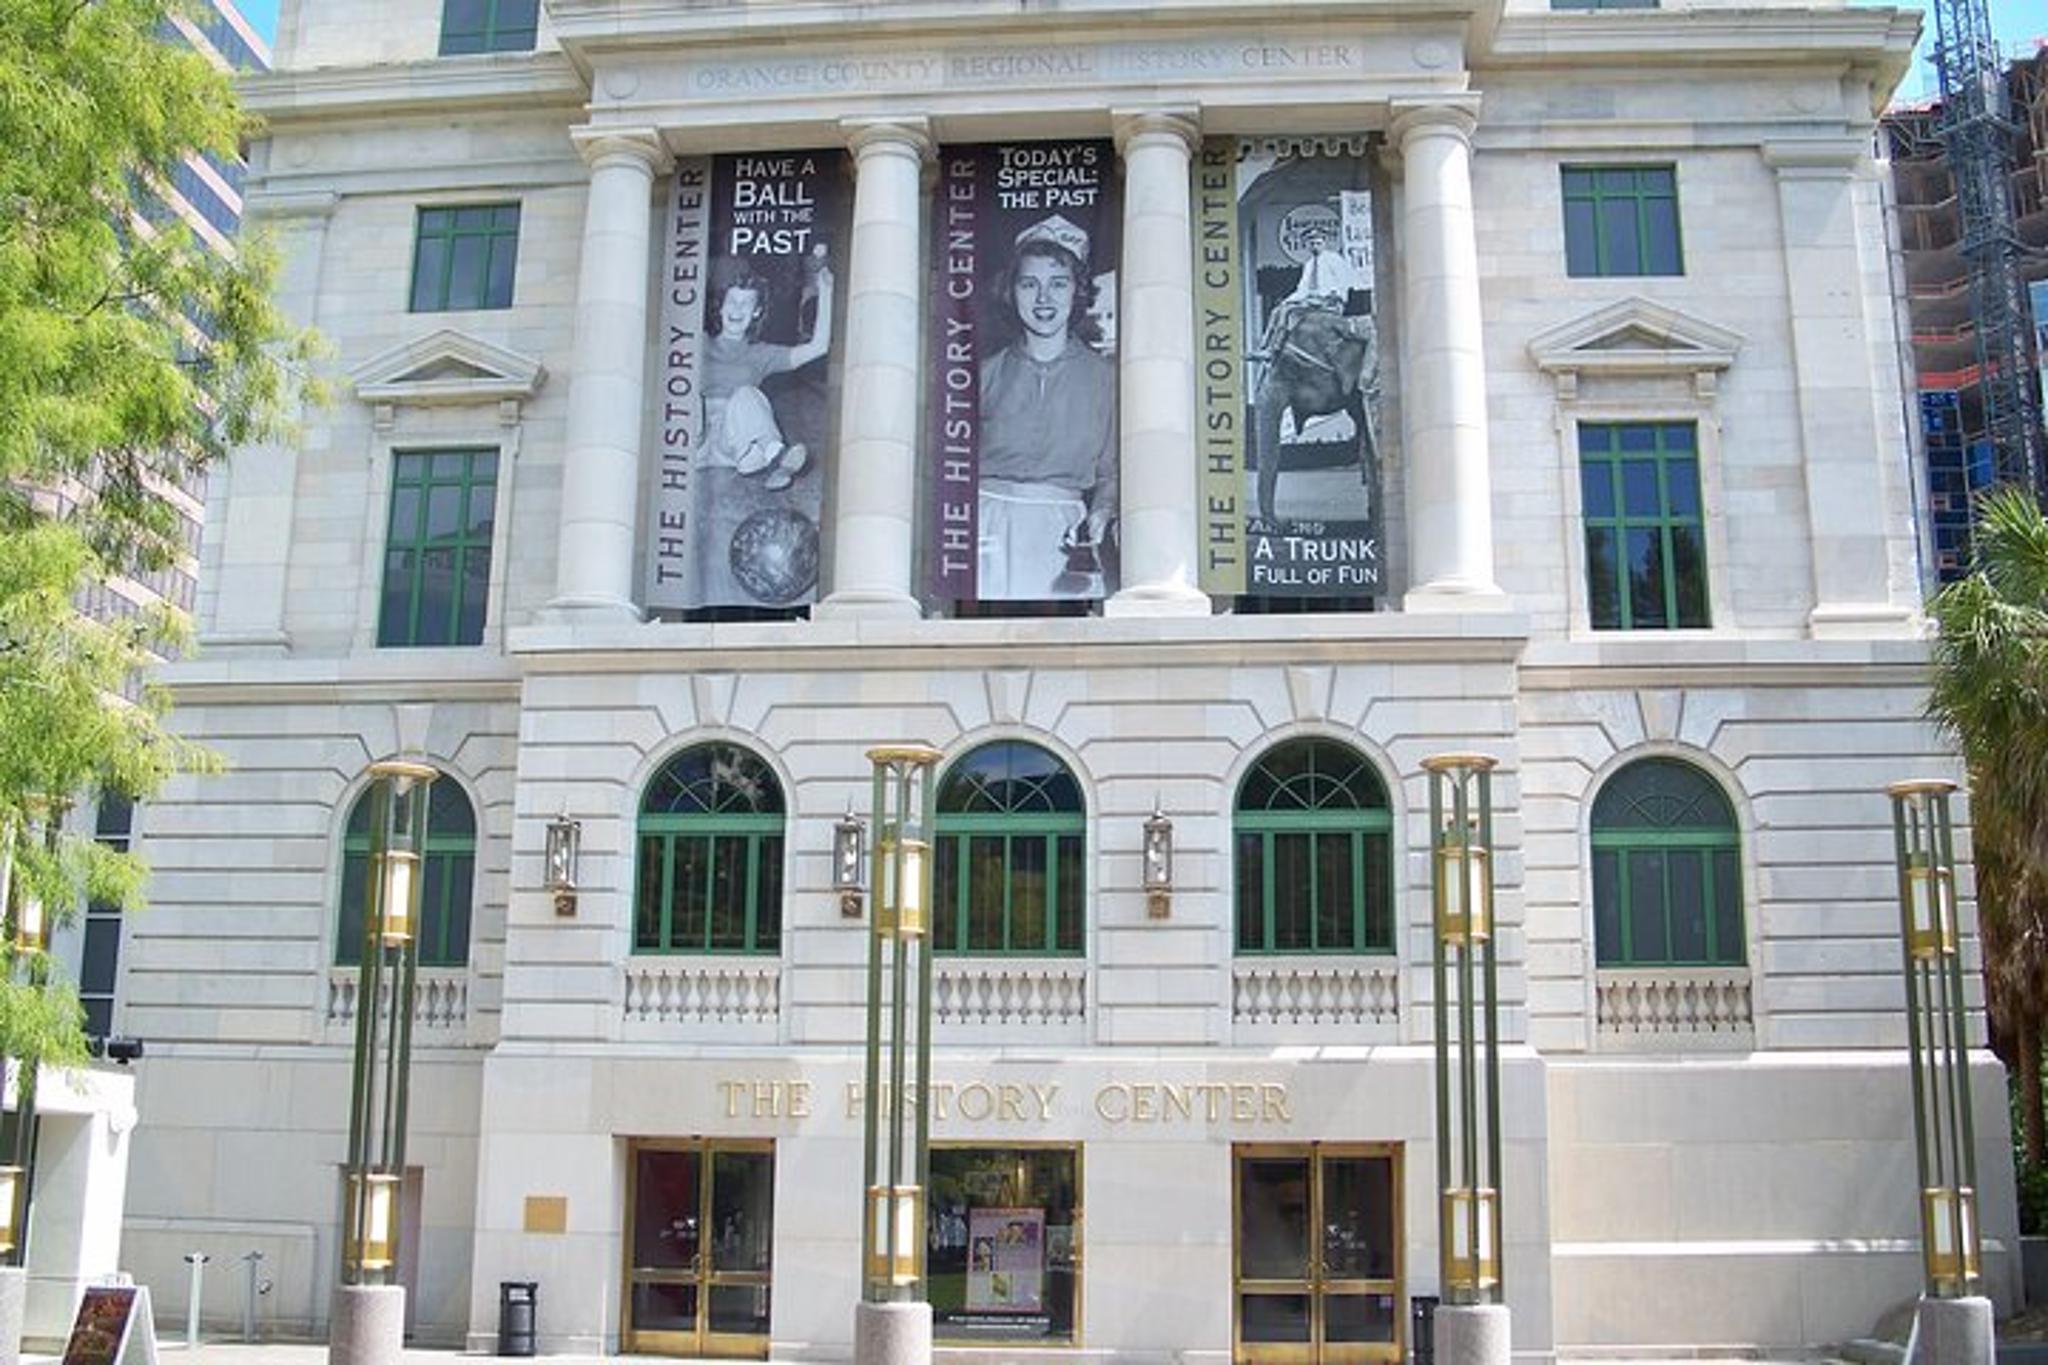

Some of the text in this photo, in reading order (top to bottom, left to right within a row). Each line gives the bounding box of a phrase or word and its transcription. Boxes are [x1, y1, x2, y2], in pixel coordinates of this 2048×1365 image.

[696, 46, 1350, 90] ORANGE COUNTY REGIONAL HISTORY CENTER
[736, 159, 816, 177] HAVE A
[1000, 148, 1097, 168] TODAY'S
[998, 168, 1098, 188] SPECIAL:
[734, 181, 814, 208] BALL
[999, 189, 1099, 209] THE PAST
[733, 208, 813, 225] WITH THE
[731, 227, 812, 255] PAST
[943, 158, 976, 577] THE HISTORY CENTER
[1203, 149, 1235, 569] THE HISTORY CENTER
[657, 169, 704, 584] THE HISTORY CENTER
[1254, 536, 1375, 561] A TRUNK
[1253, 565, 1378, 584] FULL OF FUN
[717, 1080, 1293, 1122] THE HISTORY CENTER
